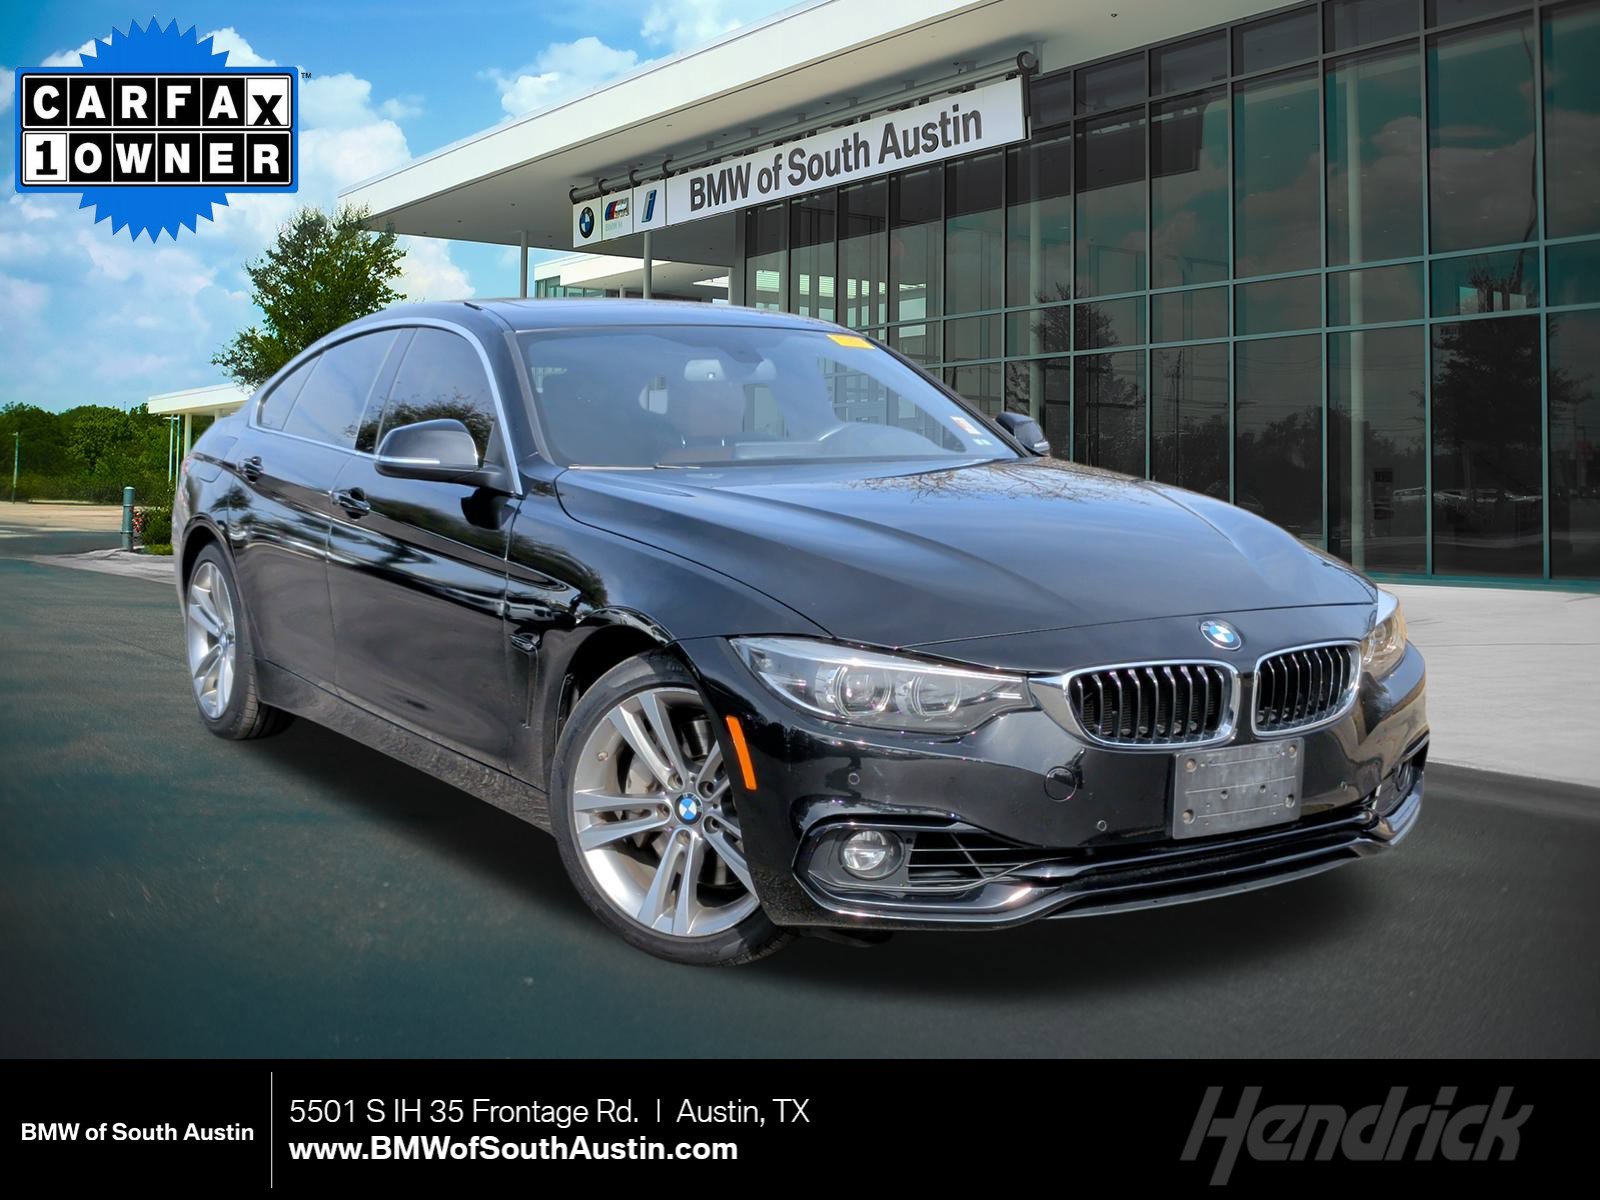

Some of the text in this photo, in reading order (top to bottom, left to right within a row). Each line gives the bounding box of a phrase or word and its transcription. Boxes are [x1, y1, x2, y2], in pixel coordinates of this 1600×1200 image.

[690, 104, 983, 212] BMW of South Austin
